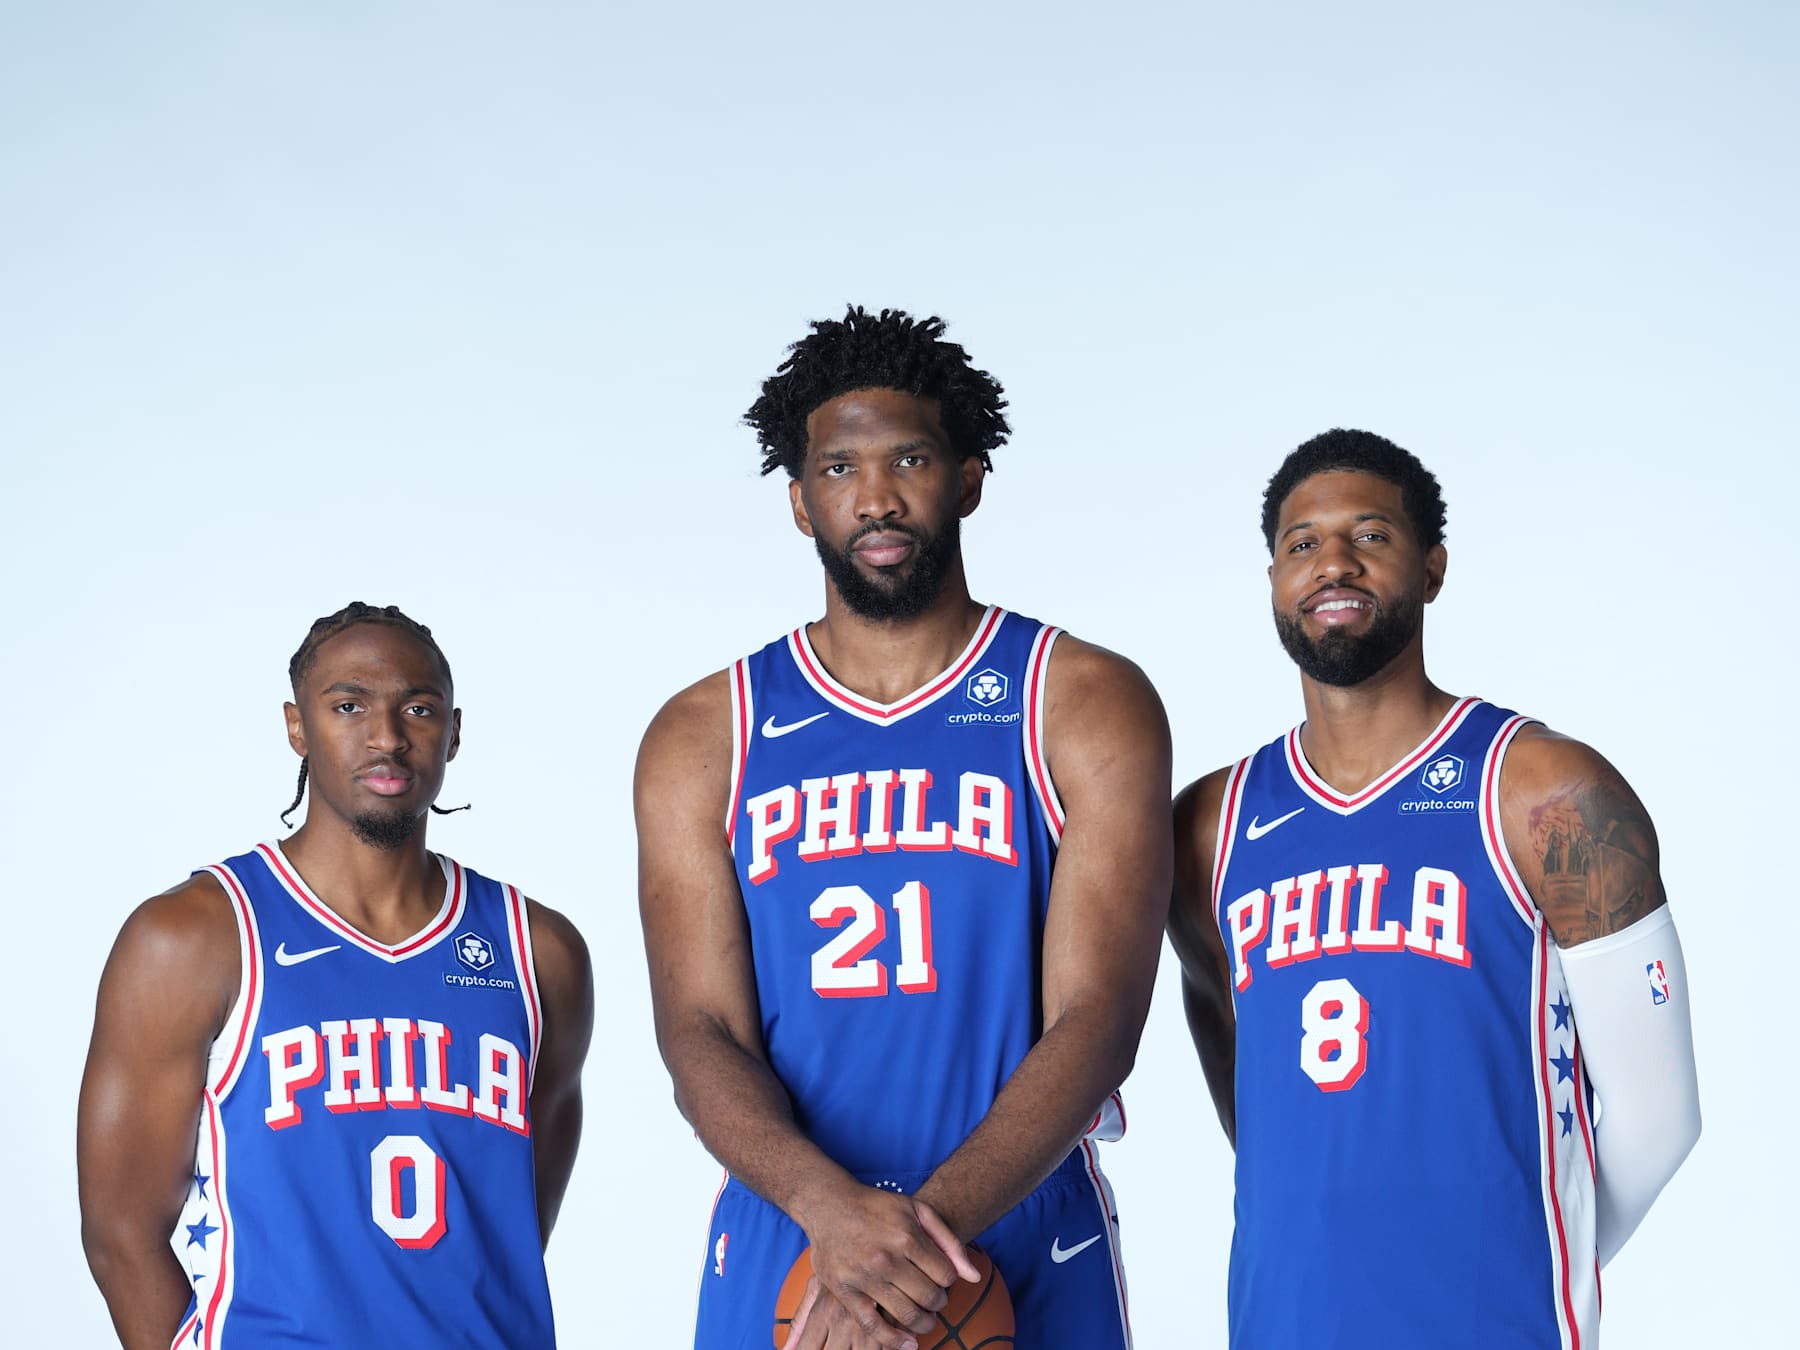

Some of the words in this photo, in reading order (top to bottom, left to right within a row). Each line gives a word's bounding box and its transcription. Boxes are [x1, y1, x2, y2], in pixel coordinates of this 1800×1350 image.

[948, 711, 1020, 724] crypto.com
[746, 768, 1019, 886] PHILA
[1401, 799, 1475, 812] crypto.com
[445, 974, 515, 990] crypto.com
[809, 880, 938, 998] 21
[1226, 863, 1472, 993] PHILA
[262, 1017, 530, 1138] PHILA
[1300, 978, 1370, 1093] 8
[370, 1135, 447, 1249] 0
